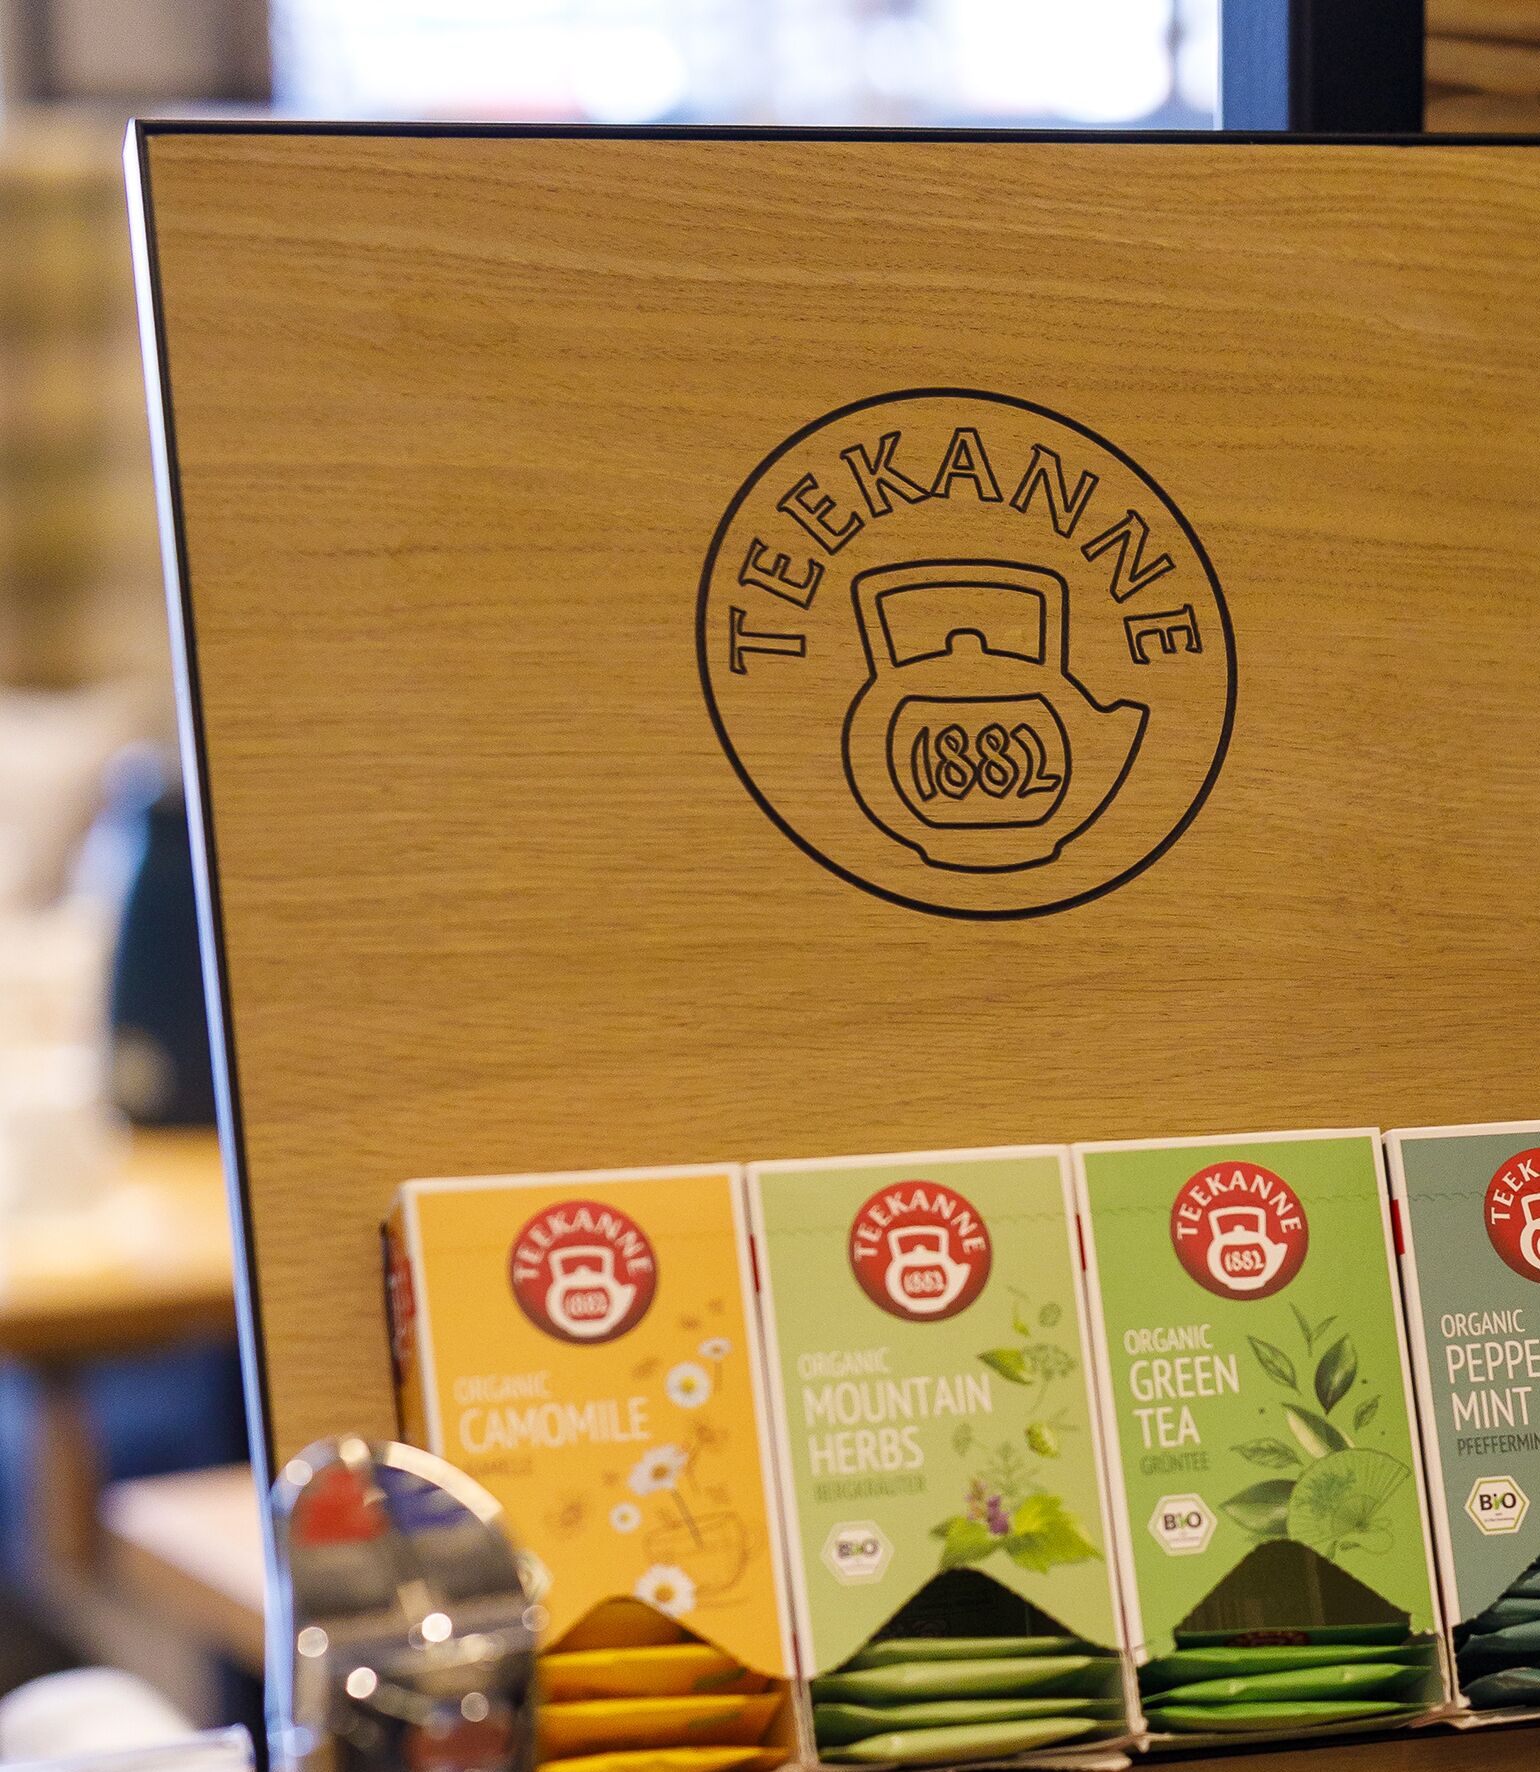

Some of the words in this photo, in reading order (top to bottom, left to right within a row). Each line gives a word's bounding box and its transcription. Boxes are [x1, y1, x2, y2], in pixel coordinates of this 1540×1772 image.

[728, 427, 1203, 676] TEEKANNE
[911, 722, 1063, 801] 1882
[854, 1188, 987, 1262] TEEKANNE
[1177, 1169, 1302, 1241] TEEKANNE
[513, 1207, 654, 1284] TEEKANNE
[1224, 1249, 1265, 1273] 1882
[1123, 1324, 1214, 1356] ORGANIC
[1440, 1308, 1526, 1339] ORGANIC
[797, 1347, 890, 1380] ORGANIC
[1129, 1354, 1240, 1402] GREEN
[458, 1396, 651, 1454] CAMOMILE
[802, 1373, 994, 1426] MOUNTAIN
[1452, 1386, 1533, 1432] MINT
[807, 1425, 925, 1477] HERBS
[1133, 1406, 1201, 1450] TEA
